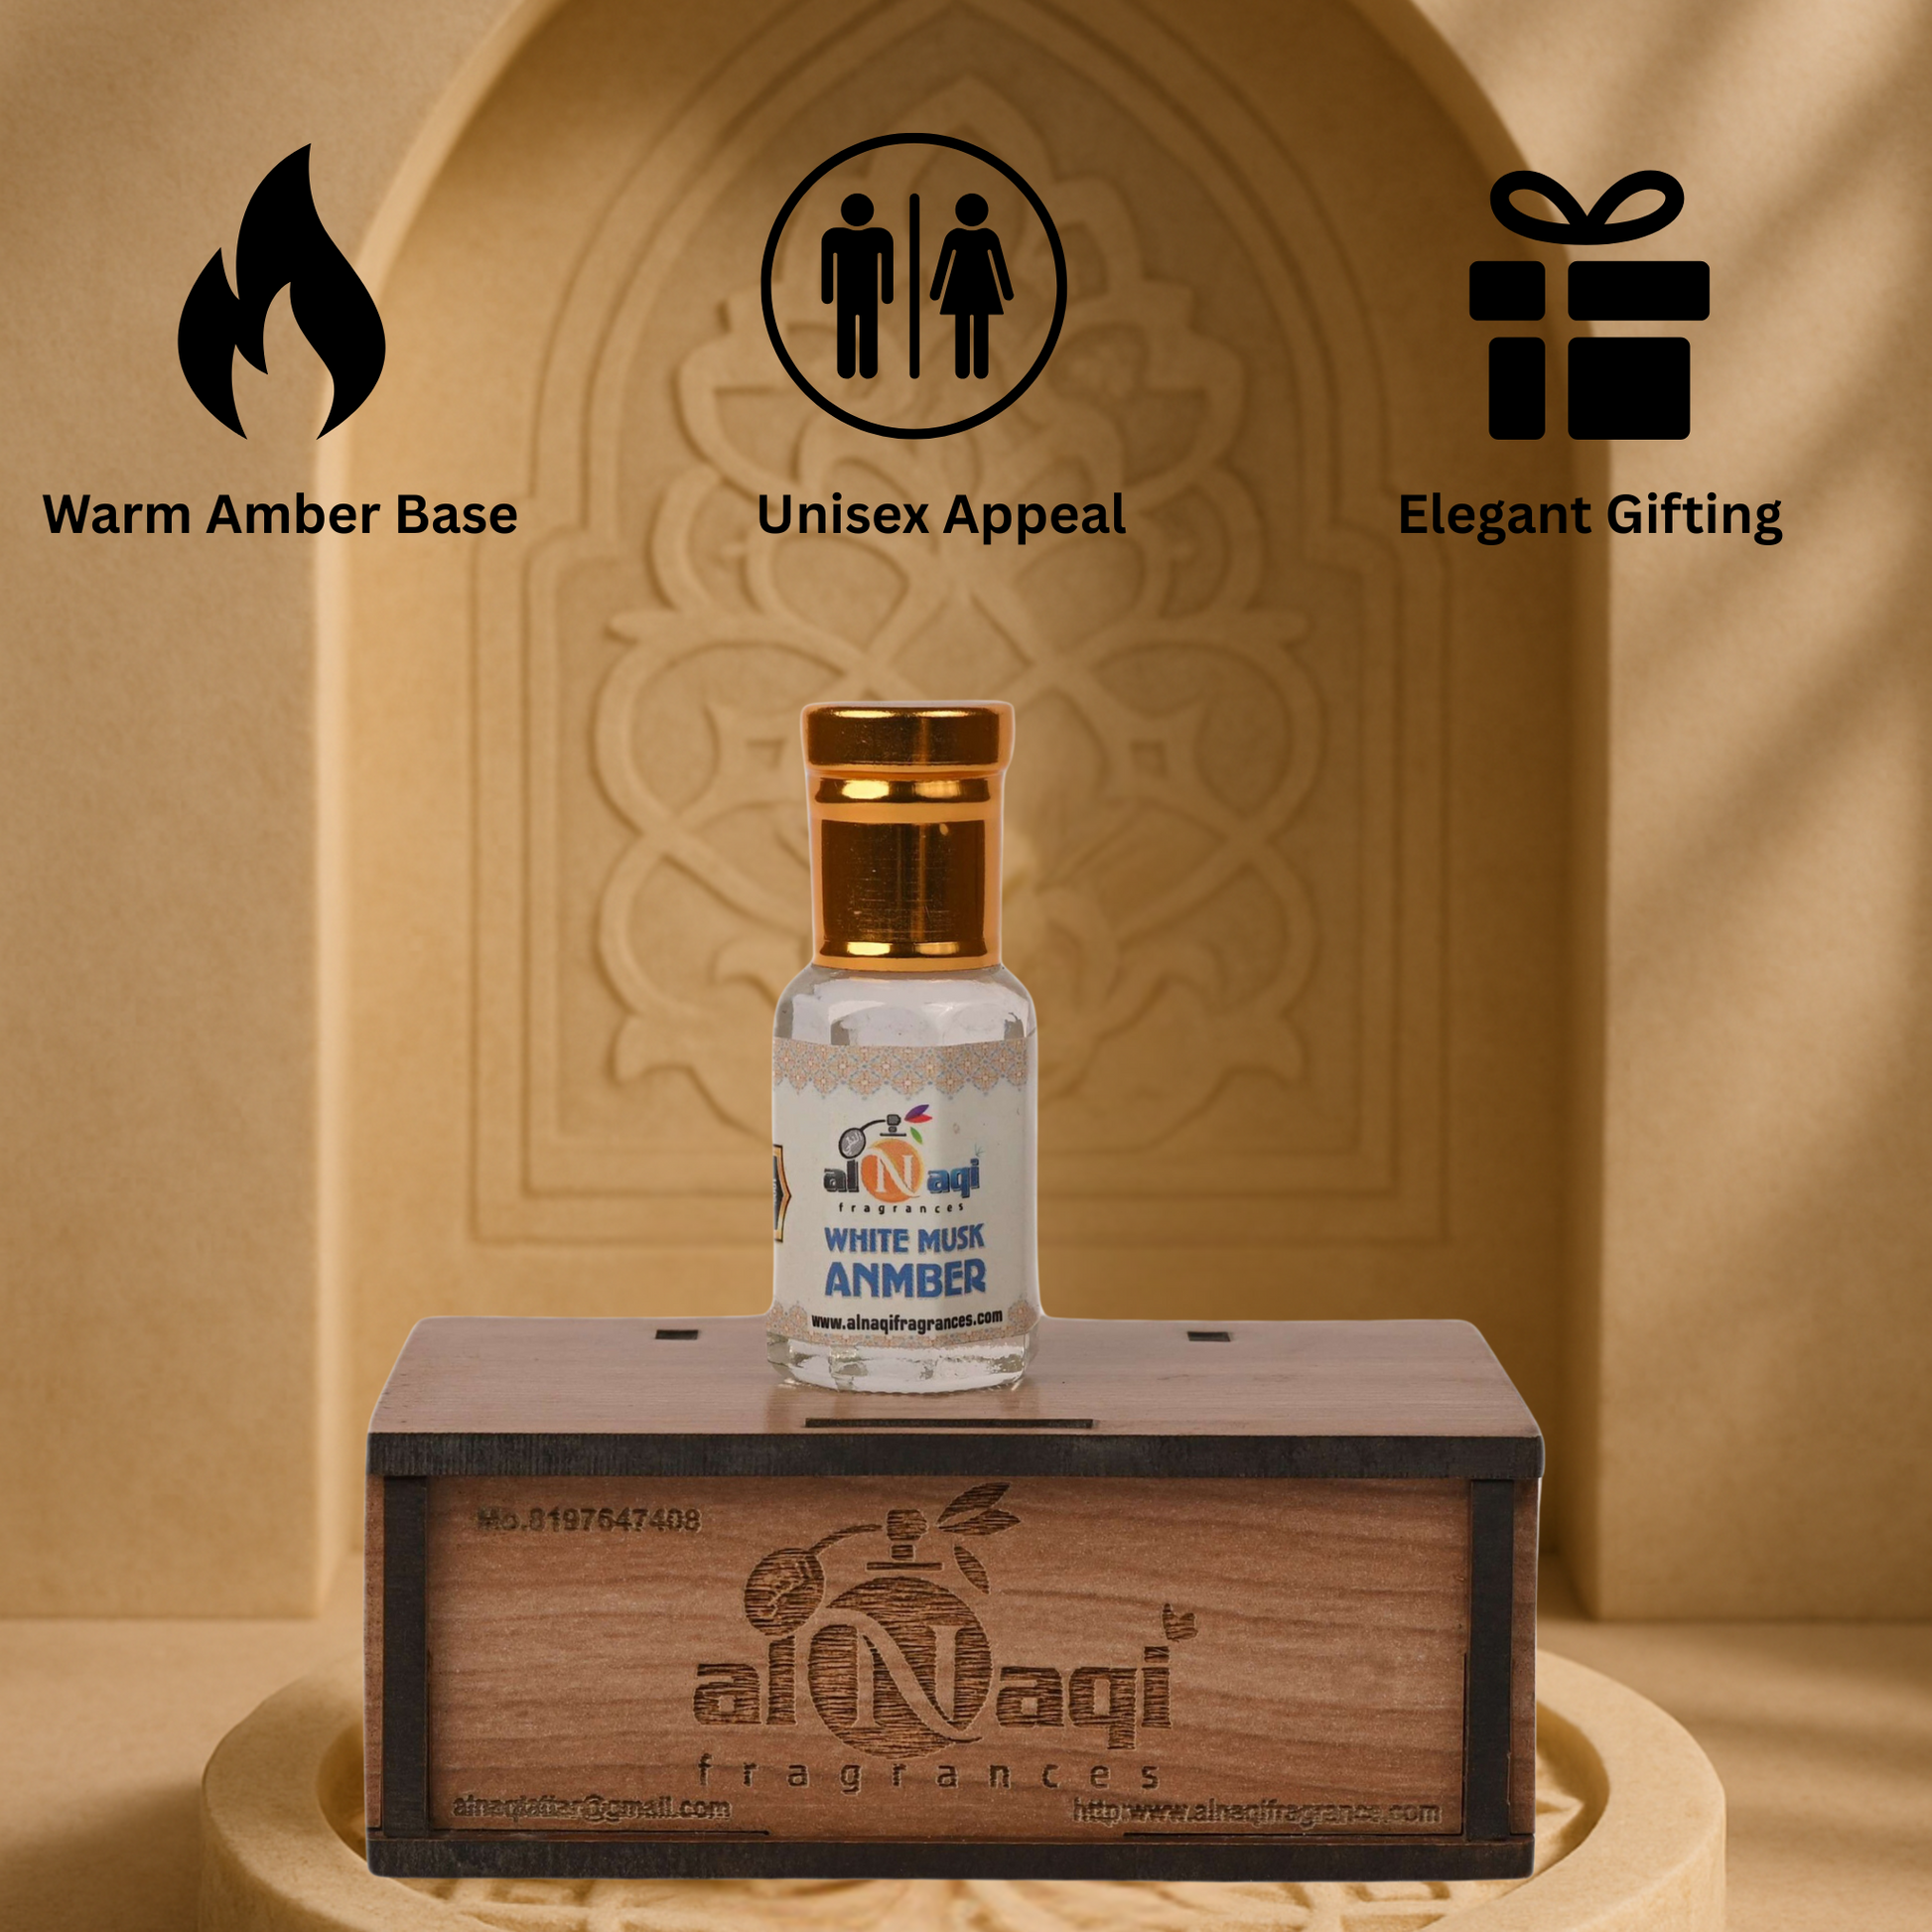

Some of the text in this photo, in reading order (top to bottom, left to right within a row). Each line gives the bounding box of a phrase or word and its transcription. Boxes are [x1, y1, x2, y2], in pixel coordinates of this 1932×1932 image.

[838, 1201, 965, 1215] fragrances
[824, 1223, 985, 1253] WHITE MUSK
[825, 1258, 987, 1299] ANMBER
[811, 1309, 1004, 1335] www.alnaqifragrances.com
[698, 1754, 1160, 1795] fragrances
